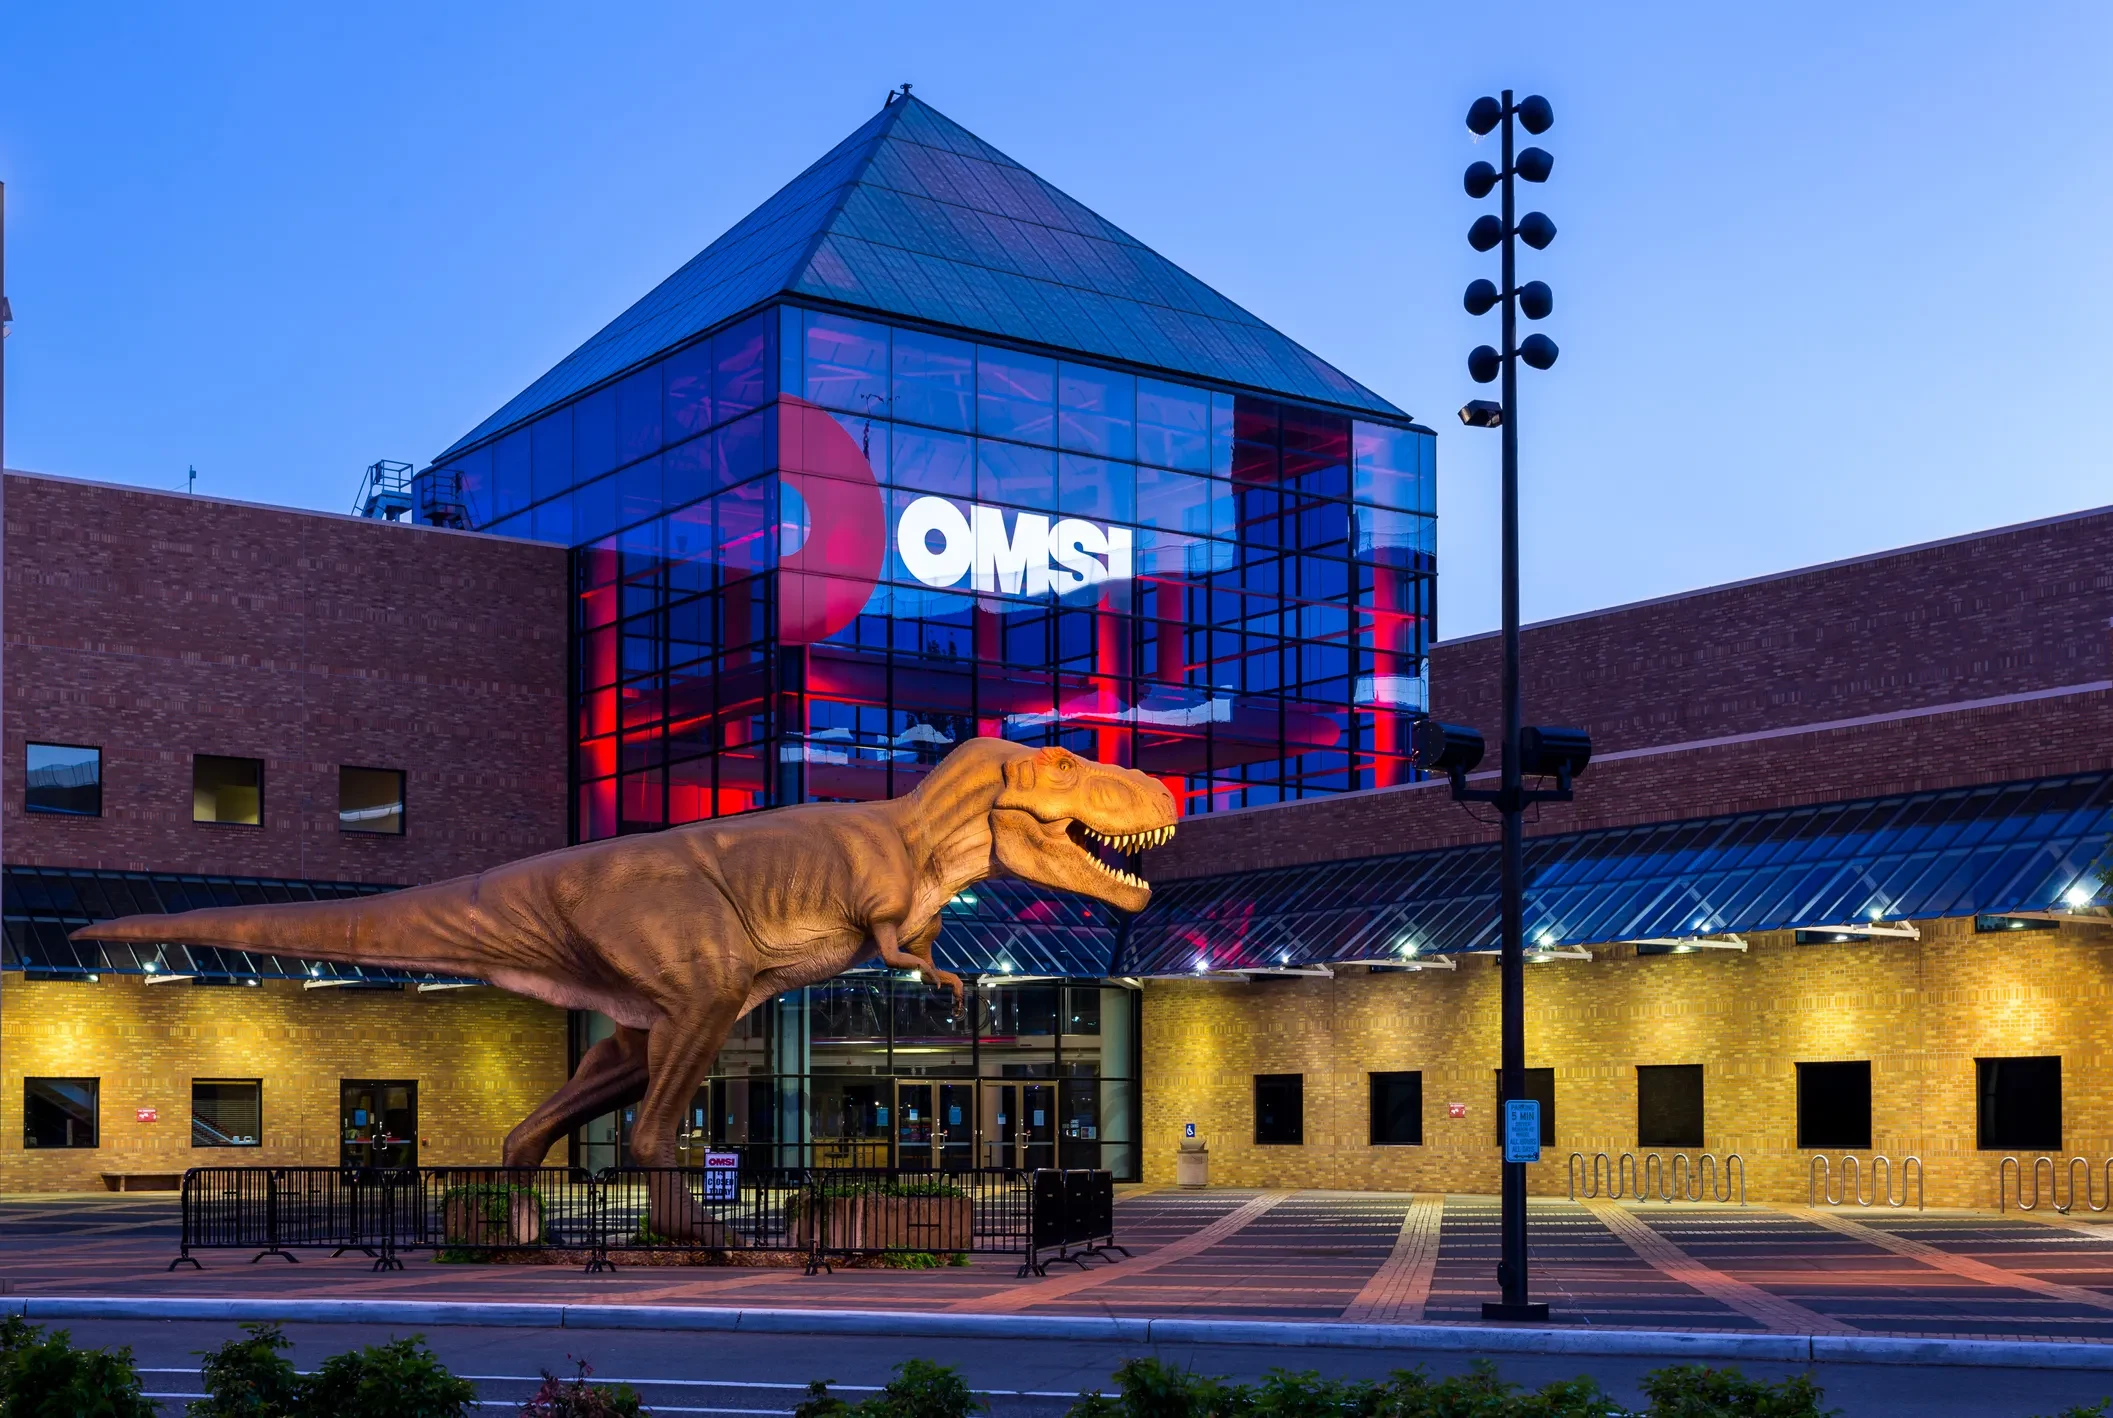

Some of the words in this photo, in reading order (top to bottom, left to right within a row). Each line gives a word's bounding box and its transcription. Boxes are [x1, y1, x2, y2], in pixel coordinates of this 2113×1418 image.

[897, 496, 1132, 600] OMSI
[1512, 1111, 1517, 1120] 5
[1520, 1111, 1535, 1120] MIN
[708, 1158, 735, 1166] OMSI
